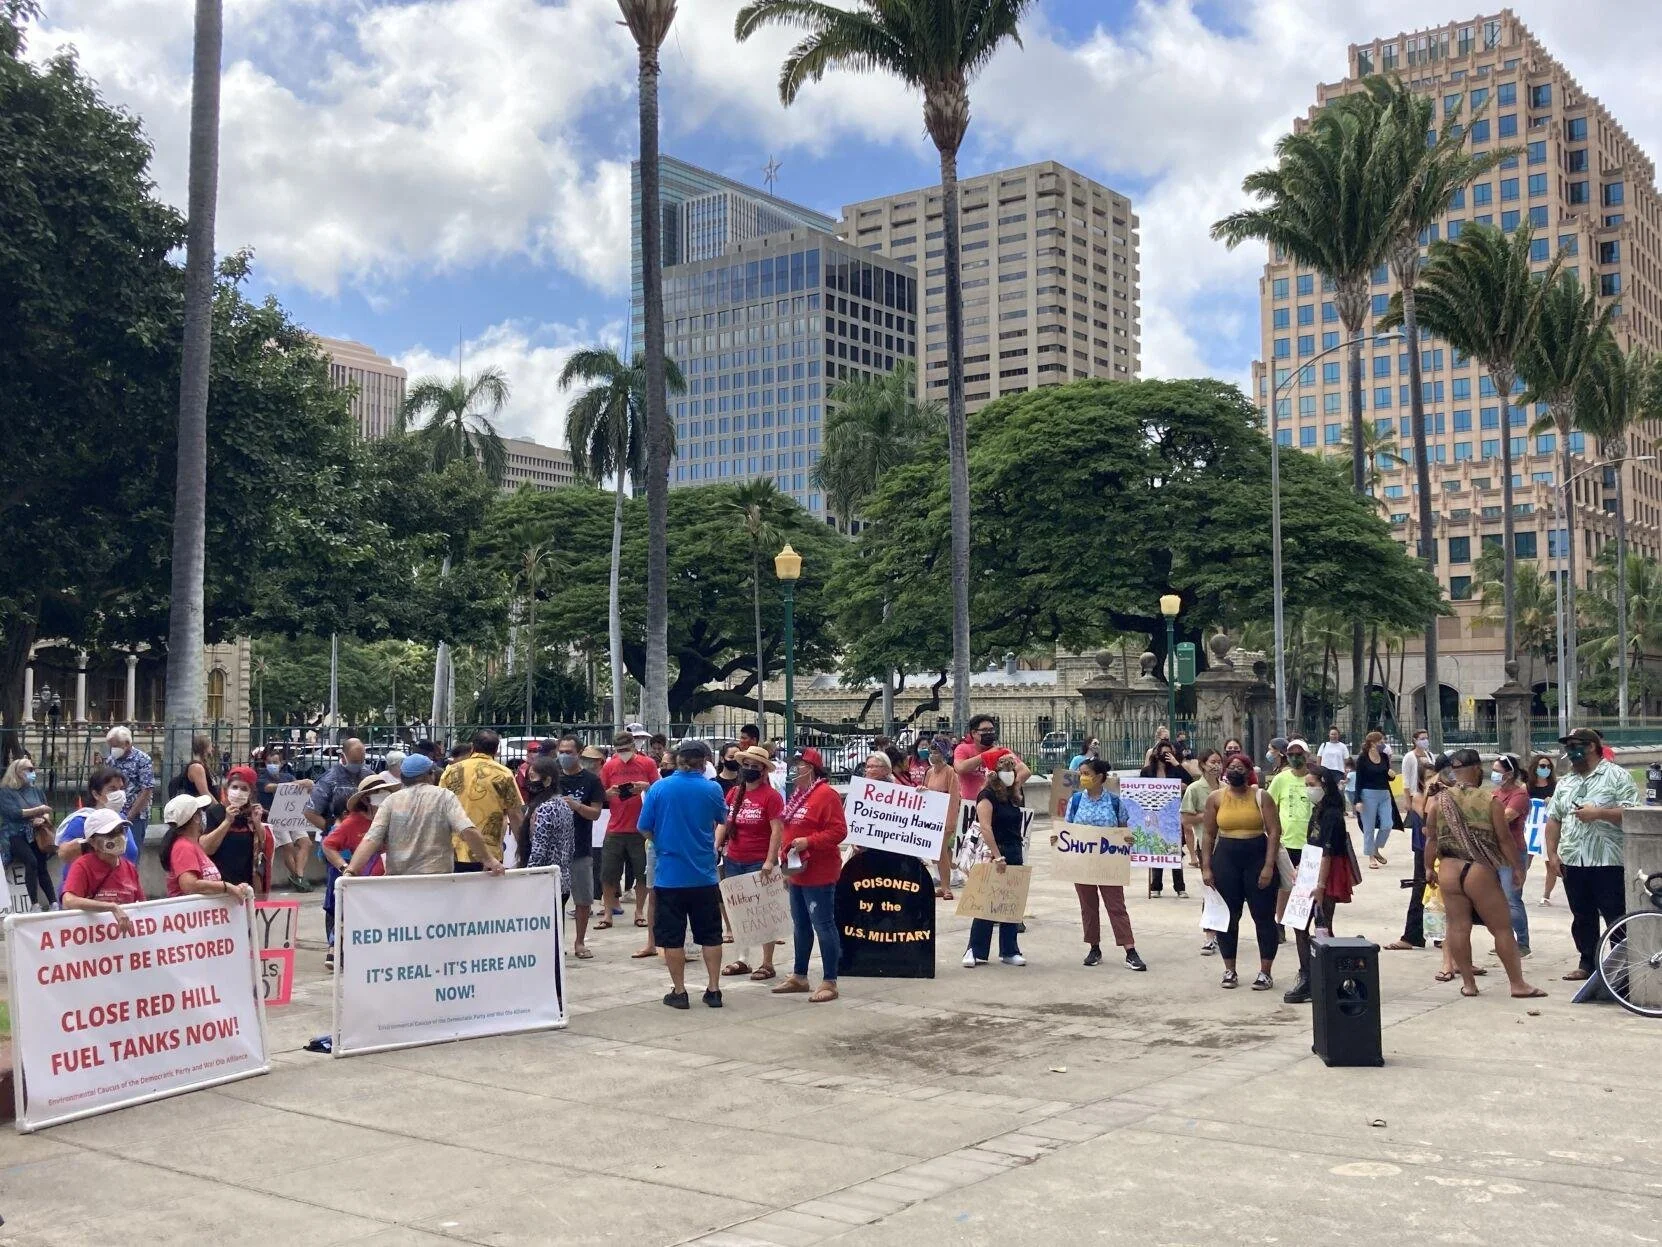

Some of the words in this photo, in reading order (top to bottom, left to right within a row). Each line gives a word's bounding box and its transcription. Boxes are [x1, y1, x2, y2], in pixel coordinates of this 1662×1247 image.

[863, 783, 895, 804] Red
[897, 790, 927, 811] Hill:
[853, 801, 908, 828] Poisoning
[910, 814, 944, 832] Hawaii
[849, 820, 865, 834] for
[866, 823, 932, 849] Imperialism
[1150, 855, 1181, 864] HILL
[853, 876, 920, 893] POISONED
[859, 899, 874, 913] by
[880, 901, 902, 912] the
[41, 931, 54, 950] A
[60, 917, 158, 948] POISONED
[162, 907, 231, 933] AQUIFER
[352, 928, 383, 945] RED
[387, 926, 422, 943] HILL
[426, 916, 551, 939] CONTAMINATION
[844, 925, 866, 939] U.S.
[868, 929, 931, 943] MILITARY
[37, 954, 124, 985] CANNOT
[130, 950, 151, 970] BE
[157, 938, 235, 966] RESTORED
[366, 967, 393, 984] IT'S
[397, 964, 432, 981] REAL
[443, 960, 467, 976] IT'S
[471, 957, 504, 973] HERE
[507, 954, 537, 970] AND
[435, 984, 475, 1002] NOW!
[61, 1001, 130, 1032] CLOSE
[136, 993, 175, 1019] RED
[182, 985, 221, 1010] HILL
[51, 1045, 104, 1075] FUEL
[110, 1029, 180, 1062] TANKS
[186, 1016, 240, 1046] NOW!
[48, 1088, 97, 1106] Environmental
[97, 1083, 120, 1094] Caucus
[121, 1080, 128, 1089] of
[128, 1078, 140, 1088] the
[140, 1069, 174, 1084] Democratic
[192, 1063, 203, 1072] and
